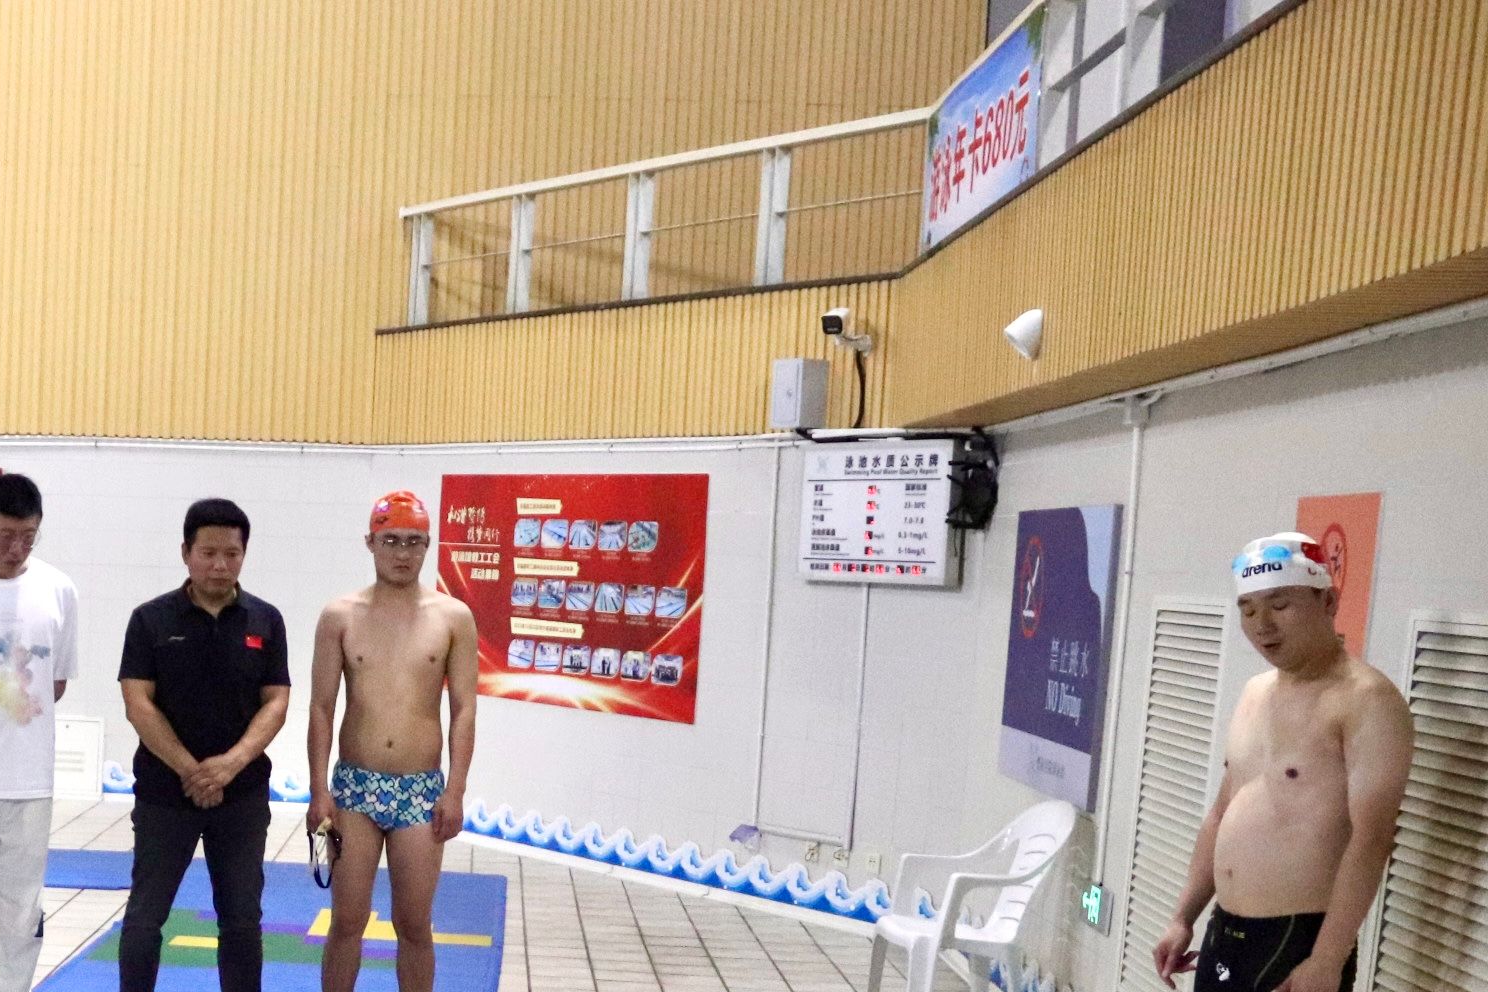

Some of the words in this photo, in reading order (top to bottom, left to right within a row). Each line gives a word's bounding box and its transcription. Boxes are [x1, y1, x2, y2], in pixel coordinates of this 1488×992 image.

[845, 454, 939, 468] 泳池水质公示牌
[1241, 561, 1283, 578] arena
